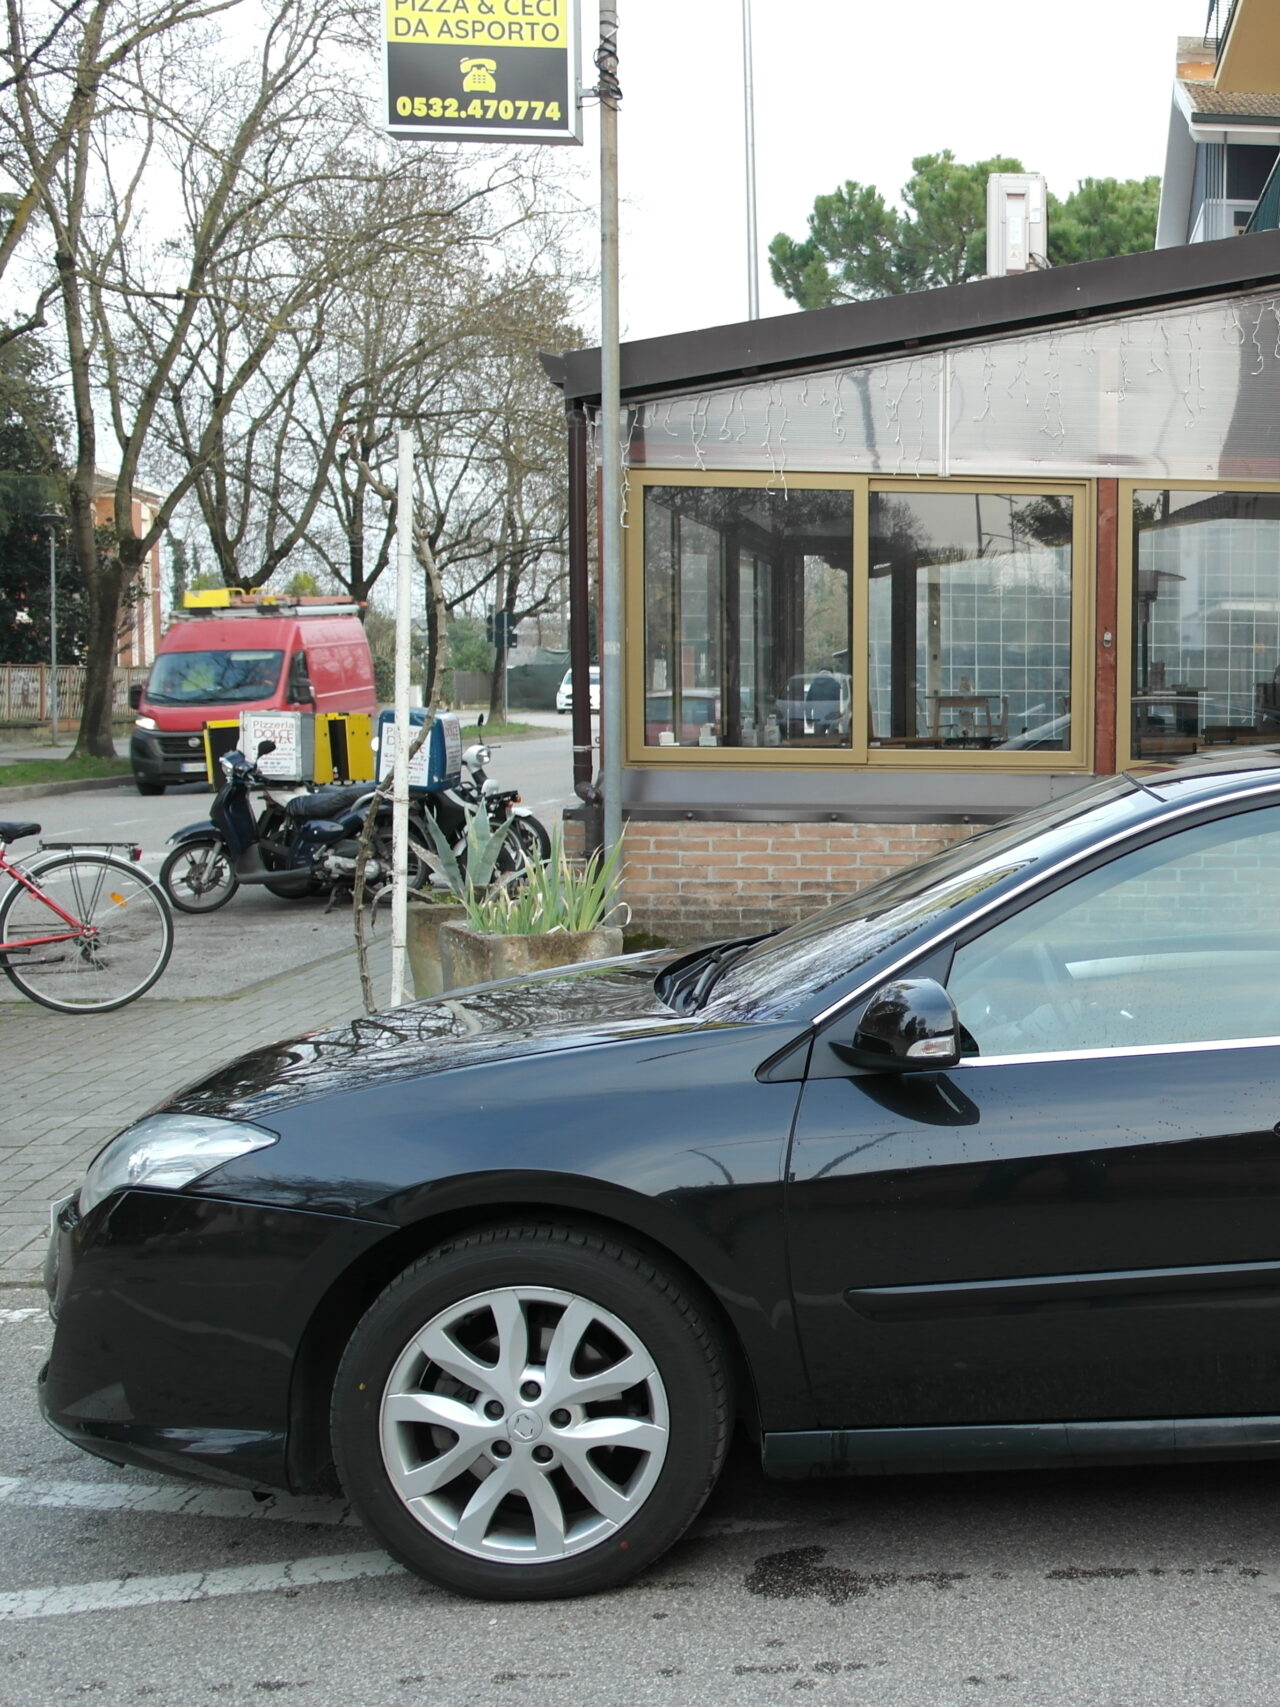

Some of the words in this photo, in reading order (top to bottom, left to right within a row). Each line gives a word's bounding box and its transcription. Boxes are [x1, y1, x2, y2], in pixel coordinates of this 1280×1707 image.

[477, 0, 495, 15] &
[504, 0, 558, 17] CECI
[394, 17, 429, 38] DA
[437, 18, 560, 42] ASPORTO
[396, 96, 561, 121] 0532.470774
[253, 720, 294, 728] Pizzeria
[254, 729, 293, 738] DOLCE
